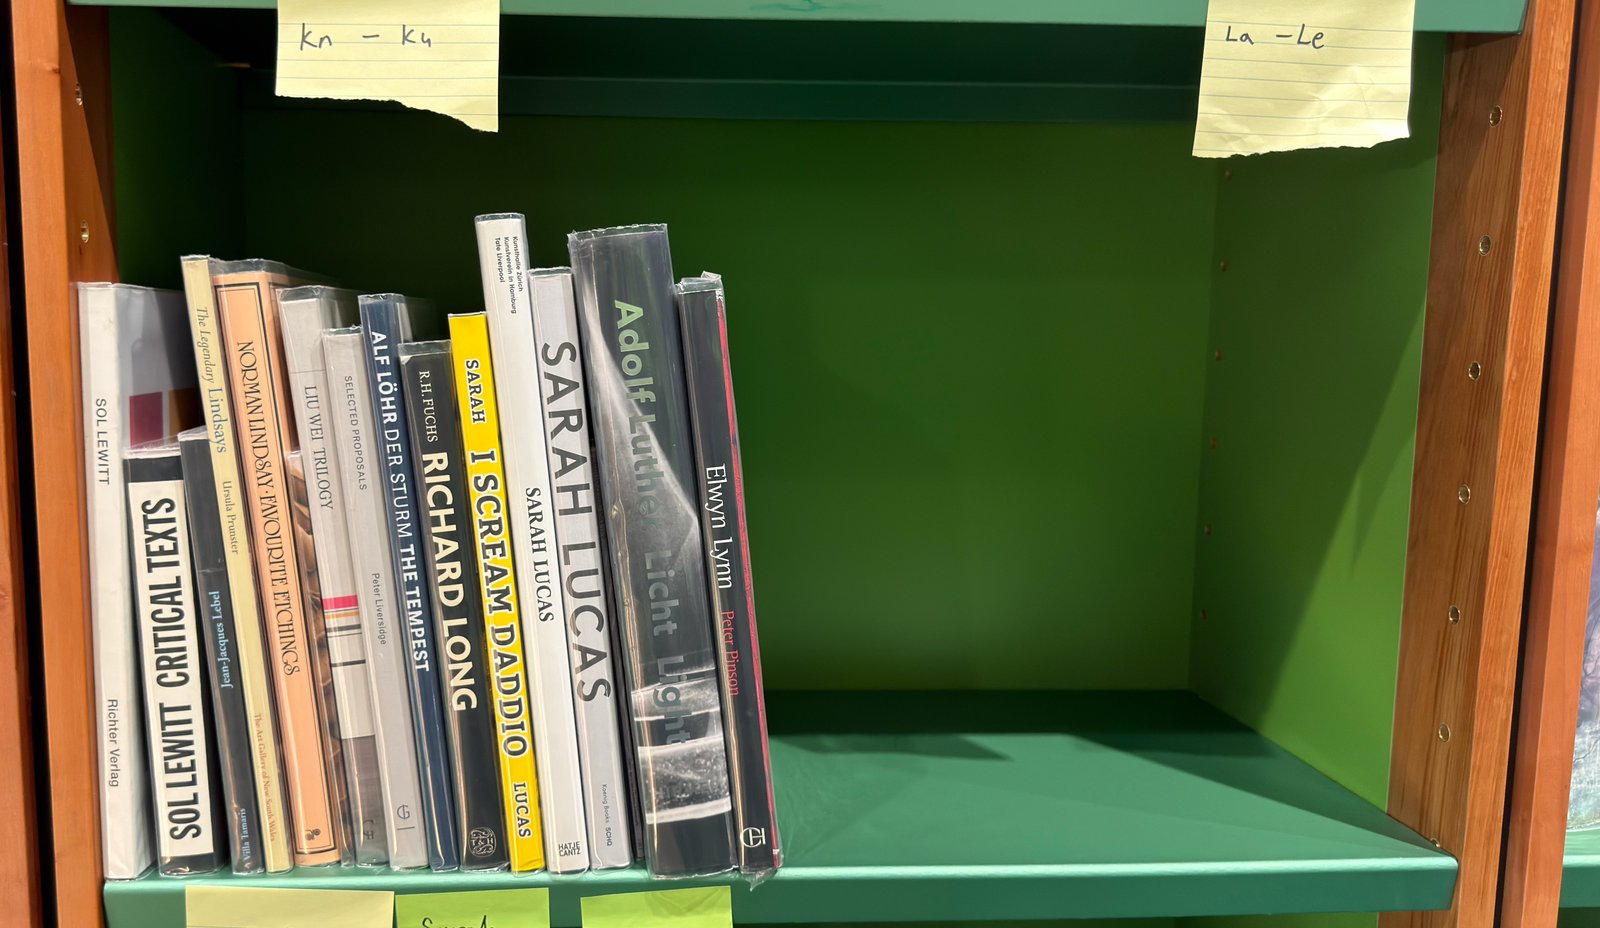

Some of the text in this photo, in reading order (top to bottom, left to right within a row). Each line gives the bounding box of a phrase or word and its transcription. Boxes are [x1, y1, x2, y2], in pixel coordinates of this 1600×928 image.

[1225, 26, 1254, 45] La
[1296, 23, 1325, 50] Le
[496, 253, 505, 283] Liverpool
[504, 236, 513, 275] Kunstverein
[509, 284, 517, 314] Hamburg
[512, 236, 521, 270] Kunsthalle
[196, 307, 226, 453] The Legendary Lindsays
[465, 360, 486, 423] SARAH
[614, 299, 656, 403] Adolf
[95, 398, 110, 485] SOL LEWITT
[304, 386, 334, 510] LIU WEI TRILOGY
[344, 375, 368, 491] SELECTED PROPOSALS
[422, 399, 438, 442] FUCHS
[223, 480, 239, 555] Ursula Prunster
[237, 341, 262, 417] NORMAN
[272, 591, 300, 676] ETCHINGS
[371, 331, 429, 672] ALF LÖHR DER STURM THE TEMPEST
[541, 341, 611, 702] SARAH LUCAS
[705, 463, 733, 589] Elwyn Lynn
[423, 452, 477, 711] RICHARD LONG
[525, 487, 555, 622] SARAH LUCAS
[208, 591, 234, 688] Jean-Jacques Lebel
[372, 573, 387, 645] Peter Liversidge
[470, 449, 528, 757] I SCREAM DADDIO
[141, 498, 202, 840] SOL LEWITT CRITICAL TEXTS
[644, 550, 693, 744] Licht Light
[721, 610, 739, 697] Peter Pinson
[107, 699, 121, 787] Richter Verlag
[254, 714, 262, 728] The
[258, 742, 267, 770] Gallery
[240, 808, 251, 861] Villa Tamaris
[513, 782, 532, 838] LUCAS
[558, 841, 580, 850] HATJE
[559, 848, 581, 857] CANTZ
